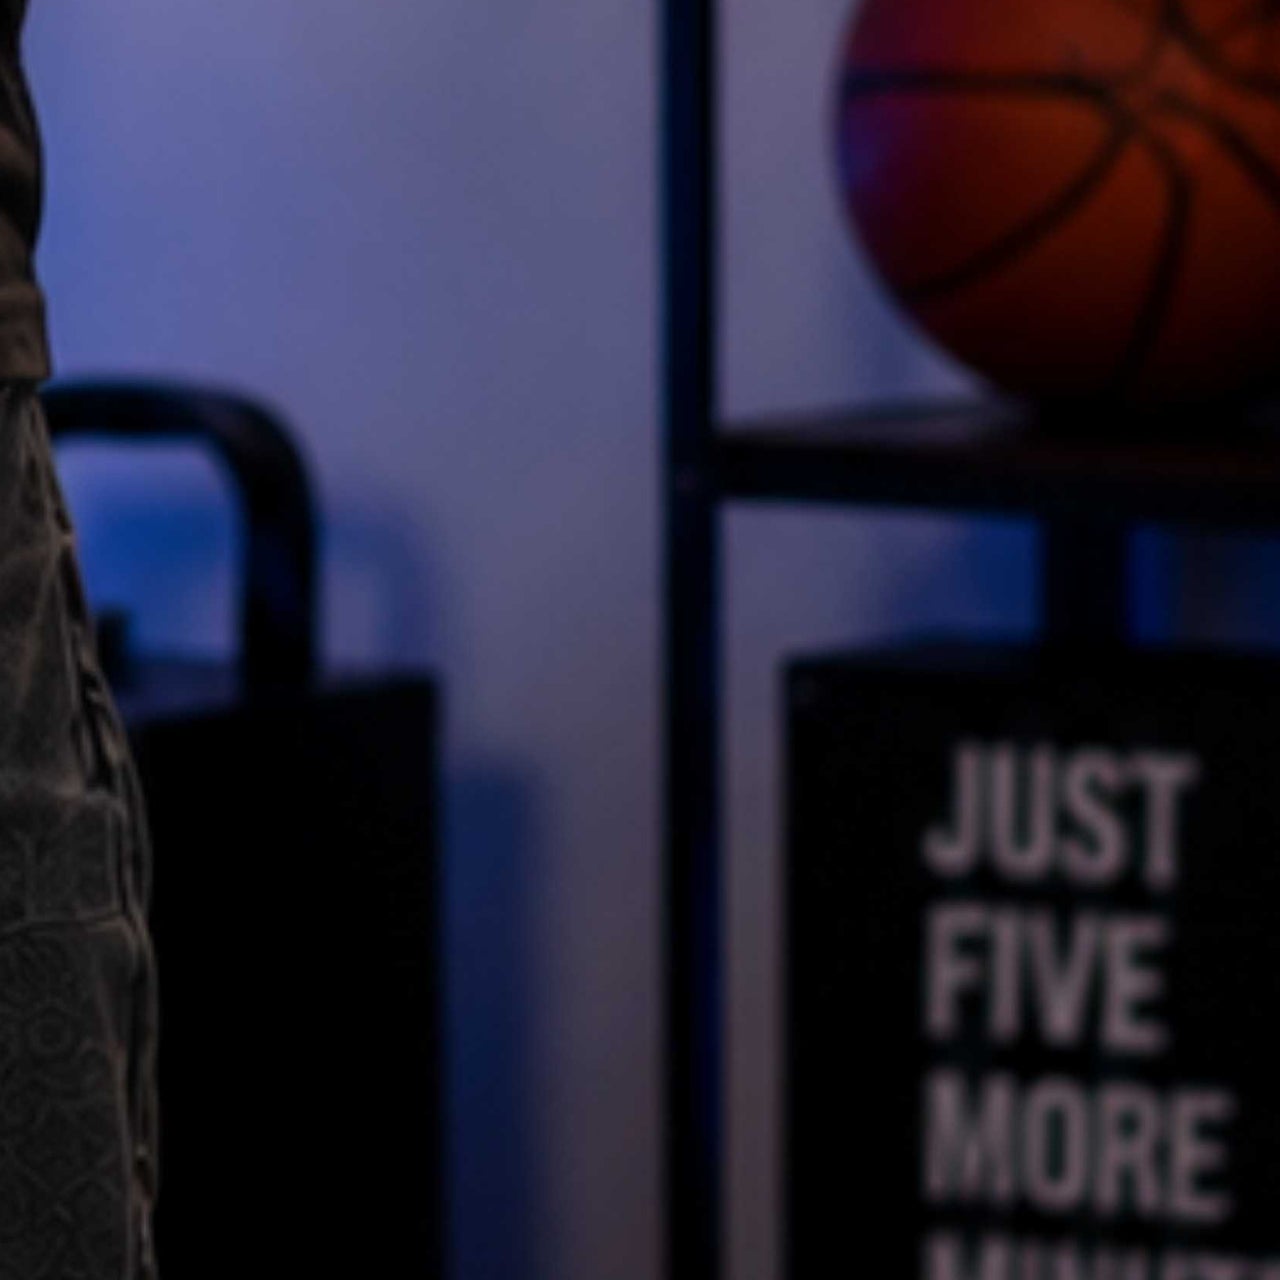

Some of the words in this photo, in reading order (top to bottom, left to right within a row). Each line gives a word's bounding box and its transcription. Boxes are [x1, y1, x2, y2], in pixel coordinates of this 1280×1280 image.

[922, 744, 1198, 888] JUST
[924, 906, 1170, 1054] FIVE
[922, 1070, 1234, 1220] MORE
